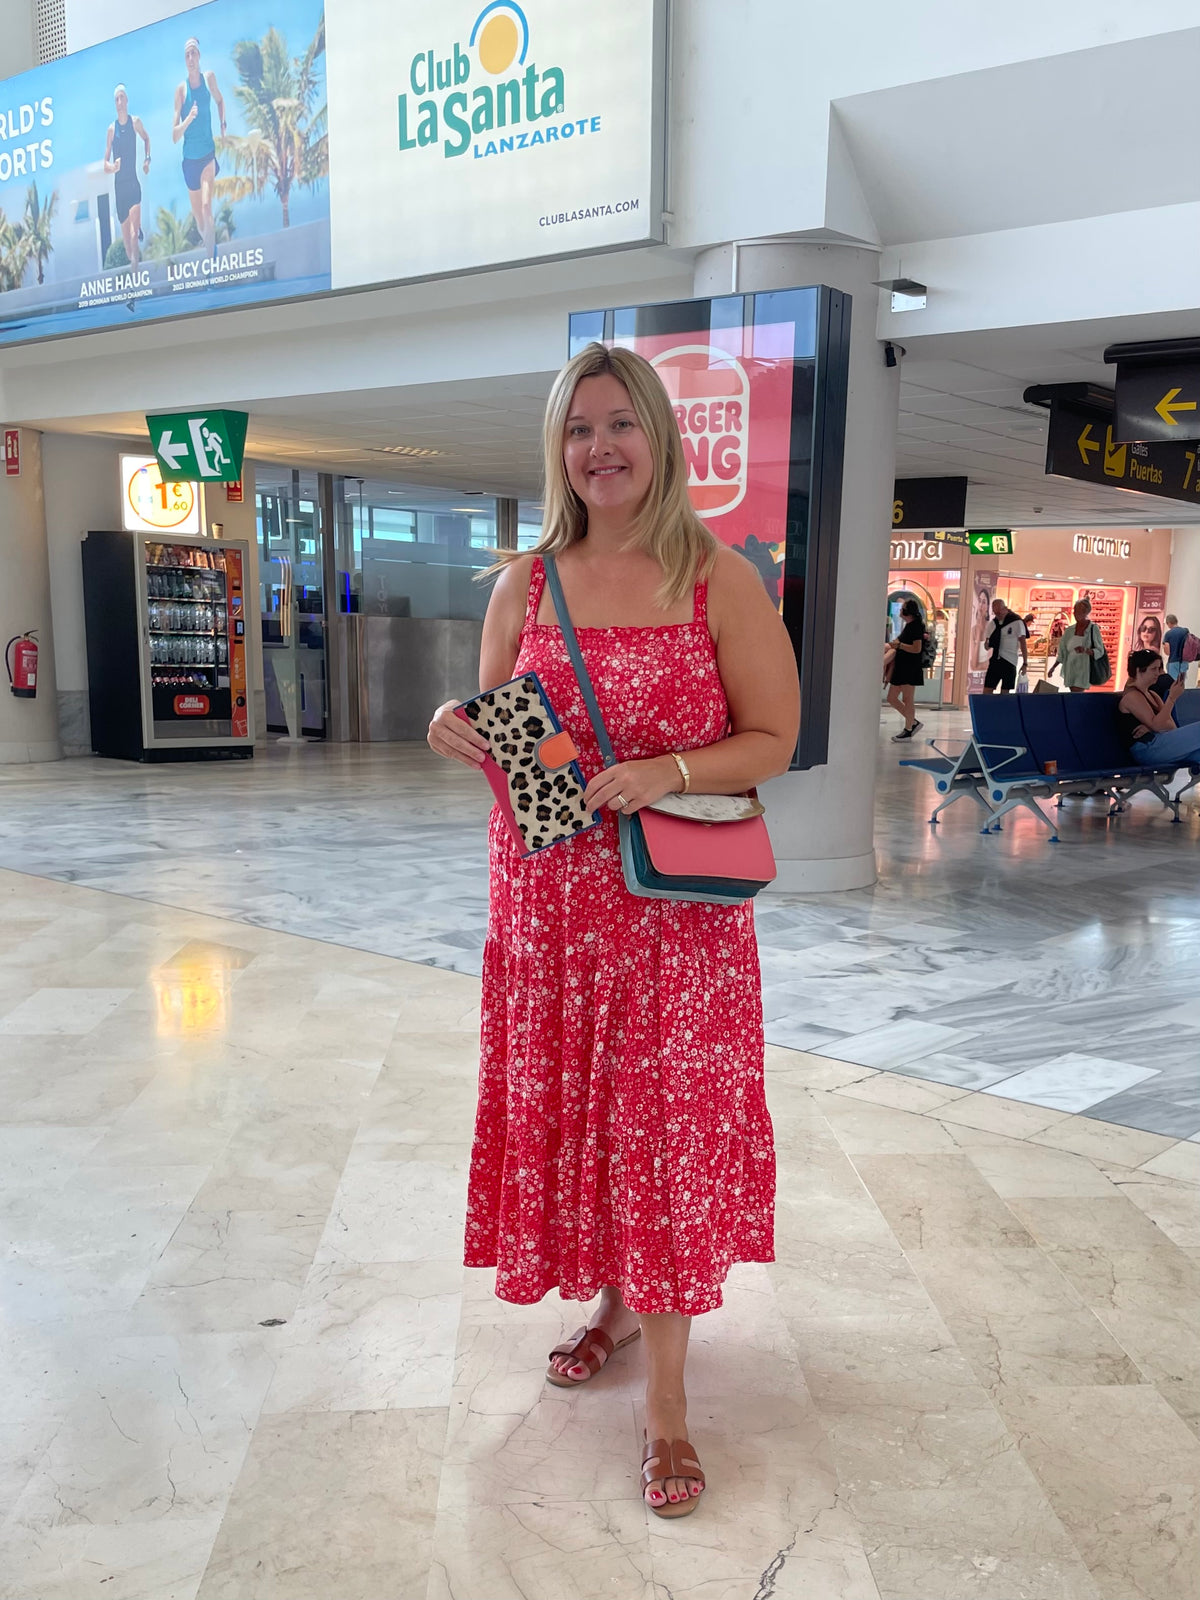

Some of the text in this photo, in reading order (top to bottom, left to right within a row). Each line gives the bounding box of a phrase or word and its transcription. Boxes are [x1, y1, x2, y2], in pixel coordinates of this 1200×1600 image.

[410, 42, 470, 96] Club
[0, 96, 54, 141] RLD'S
[473, 115, 602, 159] LANZAROTE
[0, 138, 54, 181] ORTS
[539, 199, 639, 227] CLUBLASANTA.COM
[167, 248, 264, 282] LUCY CHARLES
[80, 270, 150, 298] ANNE HAUG
[185, 279, 209, 289] IRONMAN
[209, 275, 229, 285] WORLD
[229, 270, 258, 281] CHAMPION
[110, 293, 128, 302] WORLD
[127, 288, 153, 299] CHAMPION
[672, 400, 743, 435] RGER
[682, 434, 742, 482] NG
[1129, 458, 1163, 484] Puertas
[892, 500, 904, 524] 6
[890, 540, 943, 560] mira
[1073, 533, 1131, 559] miramira
